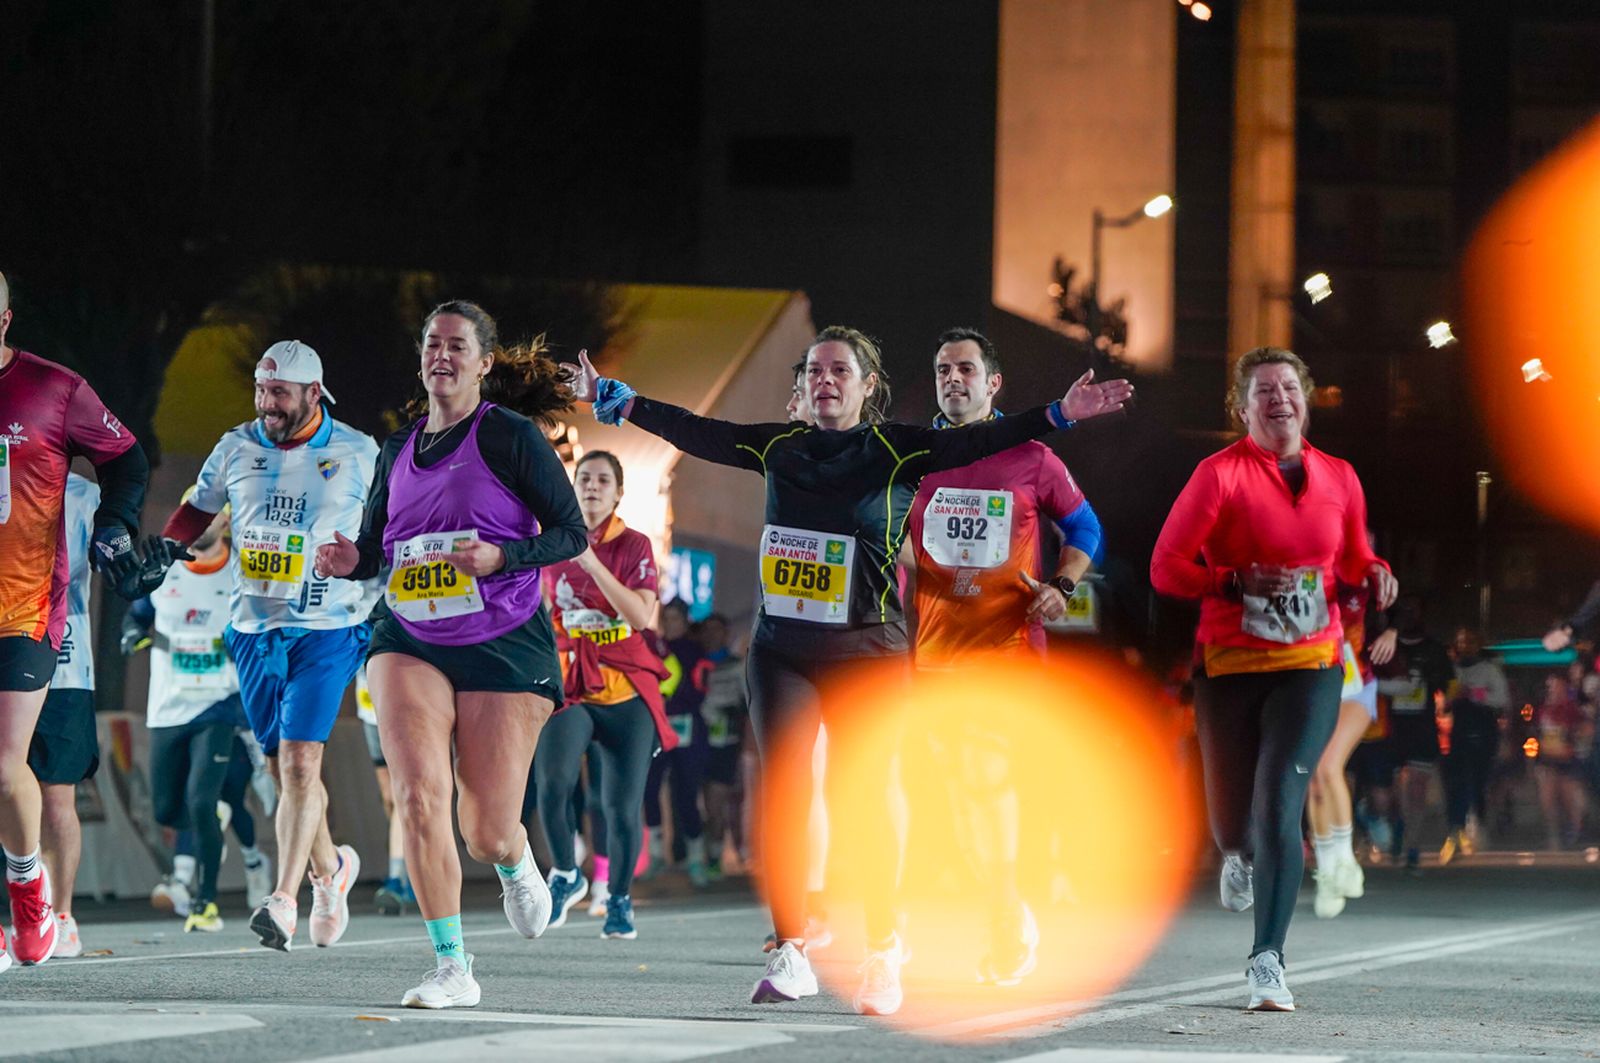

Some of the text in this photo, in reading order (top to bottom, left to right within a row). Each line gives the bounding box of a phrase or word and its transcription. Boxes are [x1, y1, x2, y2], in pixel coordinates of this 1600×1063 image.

[266, 486, 287, 494] sabor
[273, 492, 307, 512] má
[934, 505, 951, 514] SAN
[945, 496, 970, 505] NOCHE
[970, 498, 981, 506] DE
[265, 504, 304, 527] laga
[946, 516, 988, 540] 932
[432, 542, 444, 551] DE
[780, 536, 806, 548] NOCHE
[807, 541, 819, 550] DE
[768, 546, 787, 557] SAN
[787, 549, 818, 561] ANTÓN
[248, 550, 292, 575] 5981
[402, 562, 457, 591] 5913
[773, 559, 831, 592] 6758
